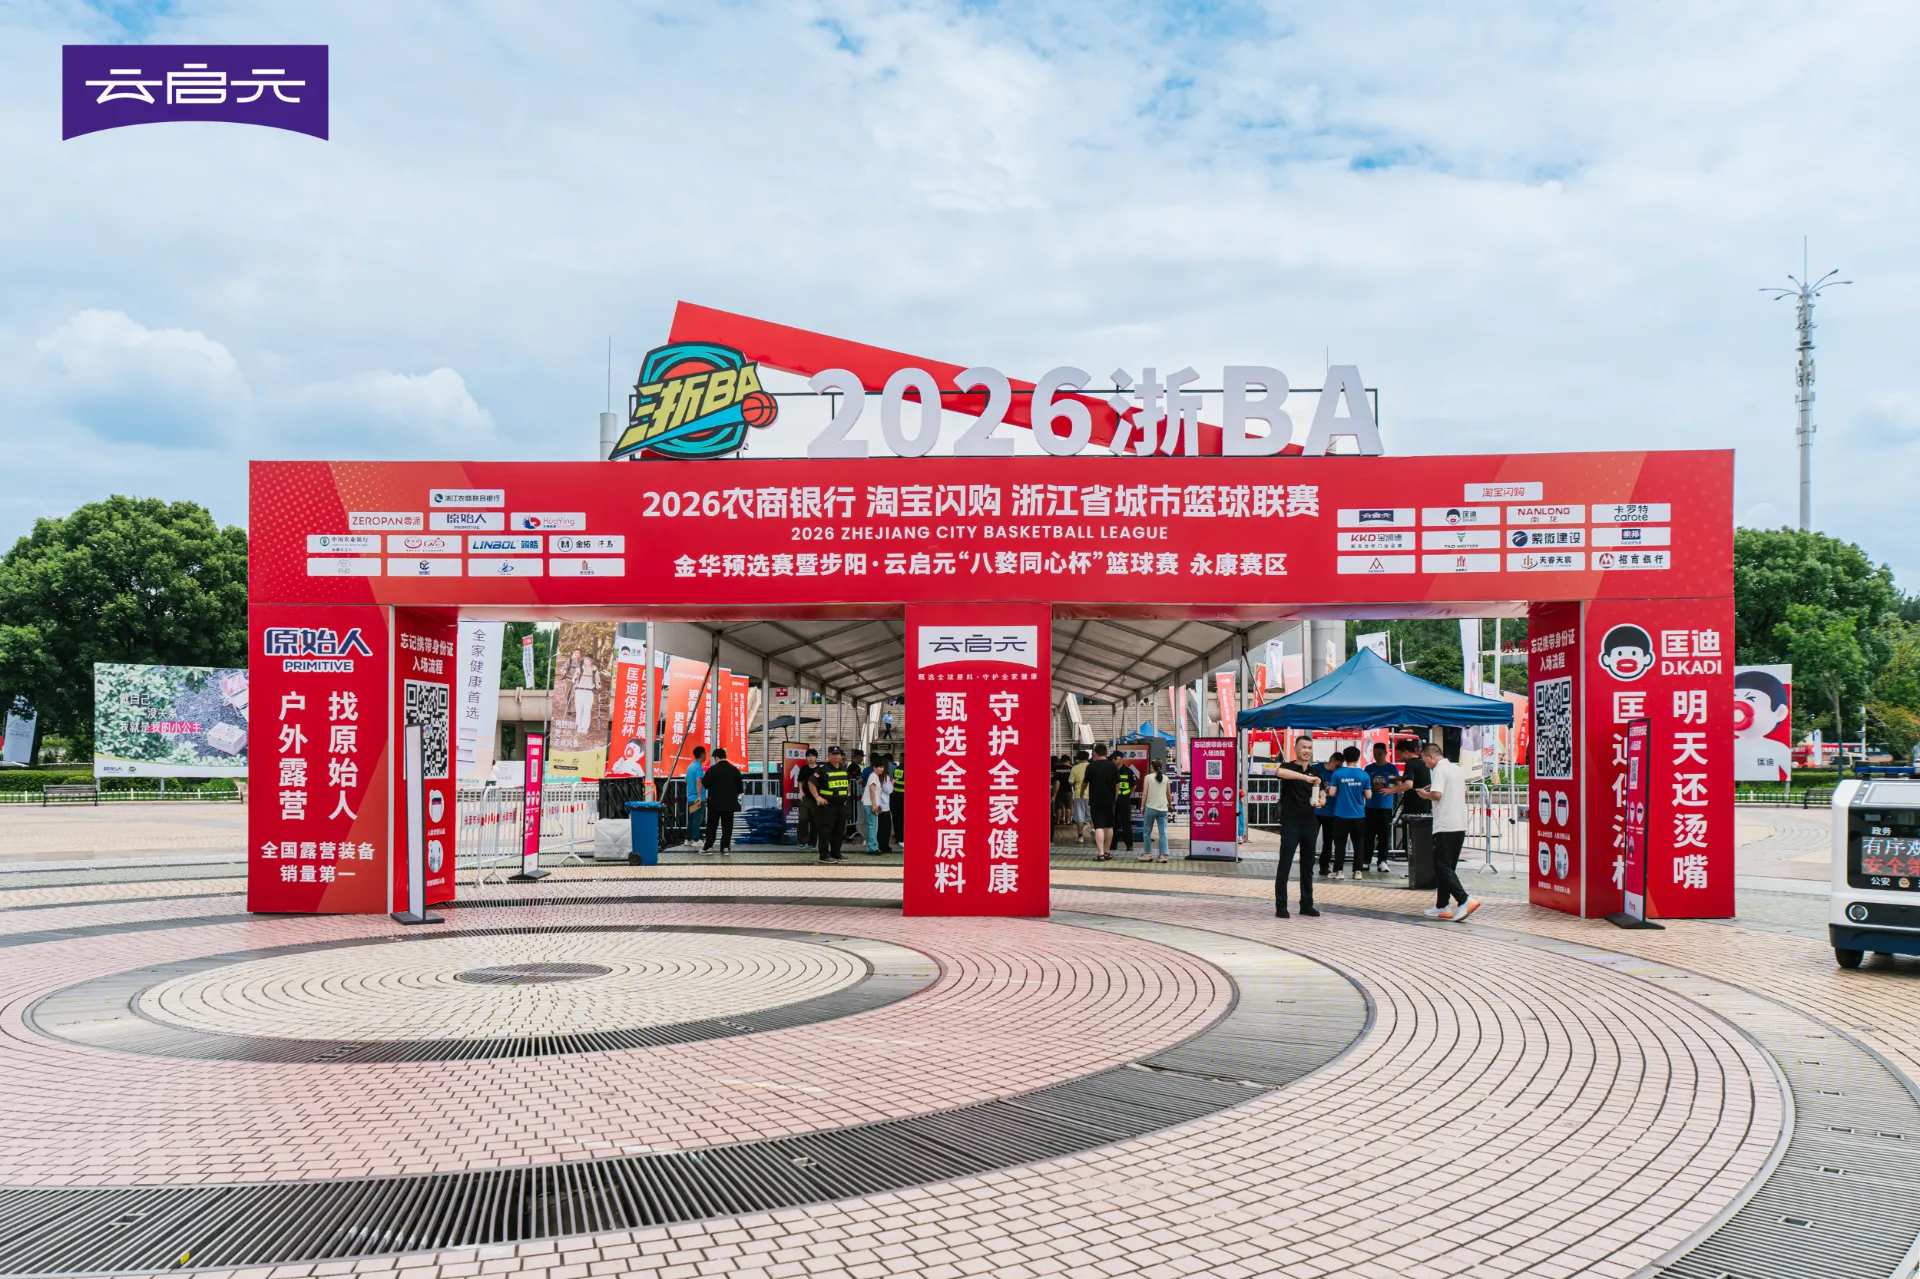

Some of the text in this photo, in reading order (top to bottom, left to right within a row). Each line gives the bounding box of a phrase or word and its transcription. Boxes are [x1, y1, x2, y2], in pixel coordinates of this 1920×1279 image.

[806, 364, 1384, 457] 2026浙BA
[444, 494, 500, 502] 浙江农商联合银行
[642, 484, 1319, 519] 2026农商银行 淘宝闪购 浙江省城市篮球联赛
[1482, 487, 1525, 498] 淘宝闪购
[446, 513, 488, 524] 原始人
[1517, 507, 1571, 516] NANLONG
[1614, 504, 1649, 515] 卡罗特
[1614, 513, 1649, 522] carote
[791, 526, 1168, 541] 2026 ZHEJIANG CITY BASKETBALL LEAGUE
[1531, 531, 1581, 545] 紫微建设
[472, 541, 517, 550] LINBOL
[1190, 552, 1288, 576] 永康赛区
[265, 628, 373, 656] 原始人
[400, 632, 454, 657] 忘记携带身份证
[929, 634, 1028, 653] 云启元
[1530, 628, 1575, 654] 忘记携带身份证
[1661, 629, 1722, 658] 匡迪
[284, 661, 353, 671] PRIMITIVE
[412, 657, 444, 675] 入场流程
[1539, 656, 1566, 673] 入场流程
[1661, 660, 1722, 676] D.KADI
[465, 628, 487, 720] 全家健康首选
[119, 693, 150, 706] 做自己
[621, 666, 640, 738] 匡迪保温杯
[147, 708, 177, 719] 没关系
[119, 721, 202, 733] 我就是我的小公主
[278, 691, 308, 820] 户外露营
[328, 690, 359, 821] 找原始人
[935, 691, 968, 894] 甄选全球原料
[987, 690, 1020, 894] 守护全家健康
[1672, 689, 1709, 890] 明天还烫嘴
[261, 841, 376, 860] 全国露营装备
[280, 865, 356, 883] 销量第一
[1871, 876, 1891, 886] 公安
